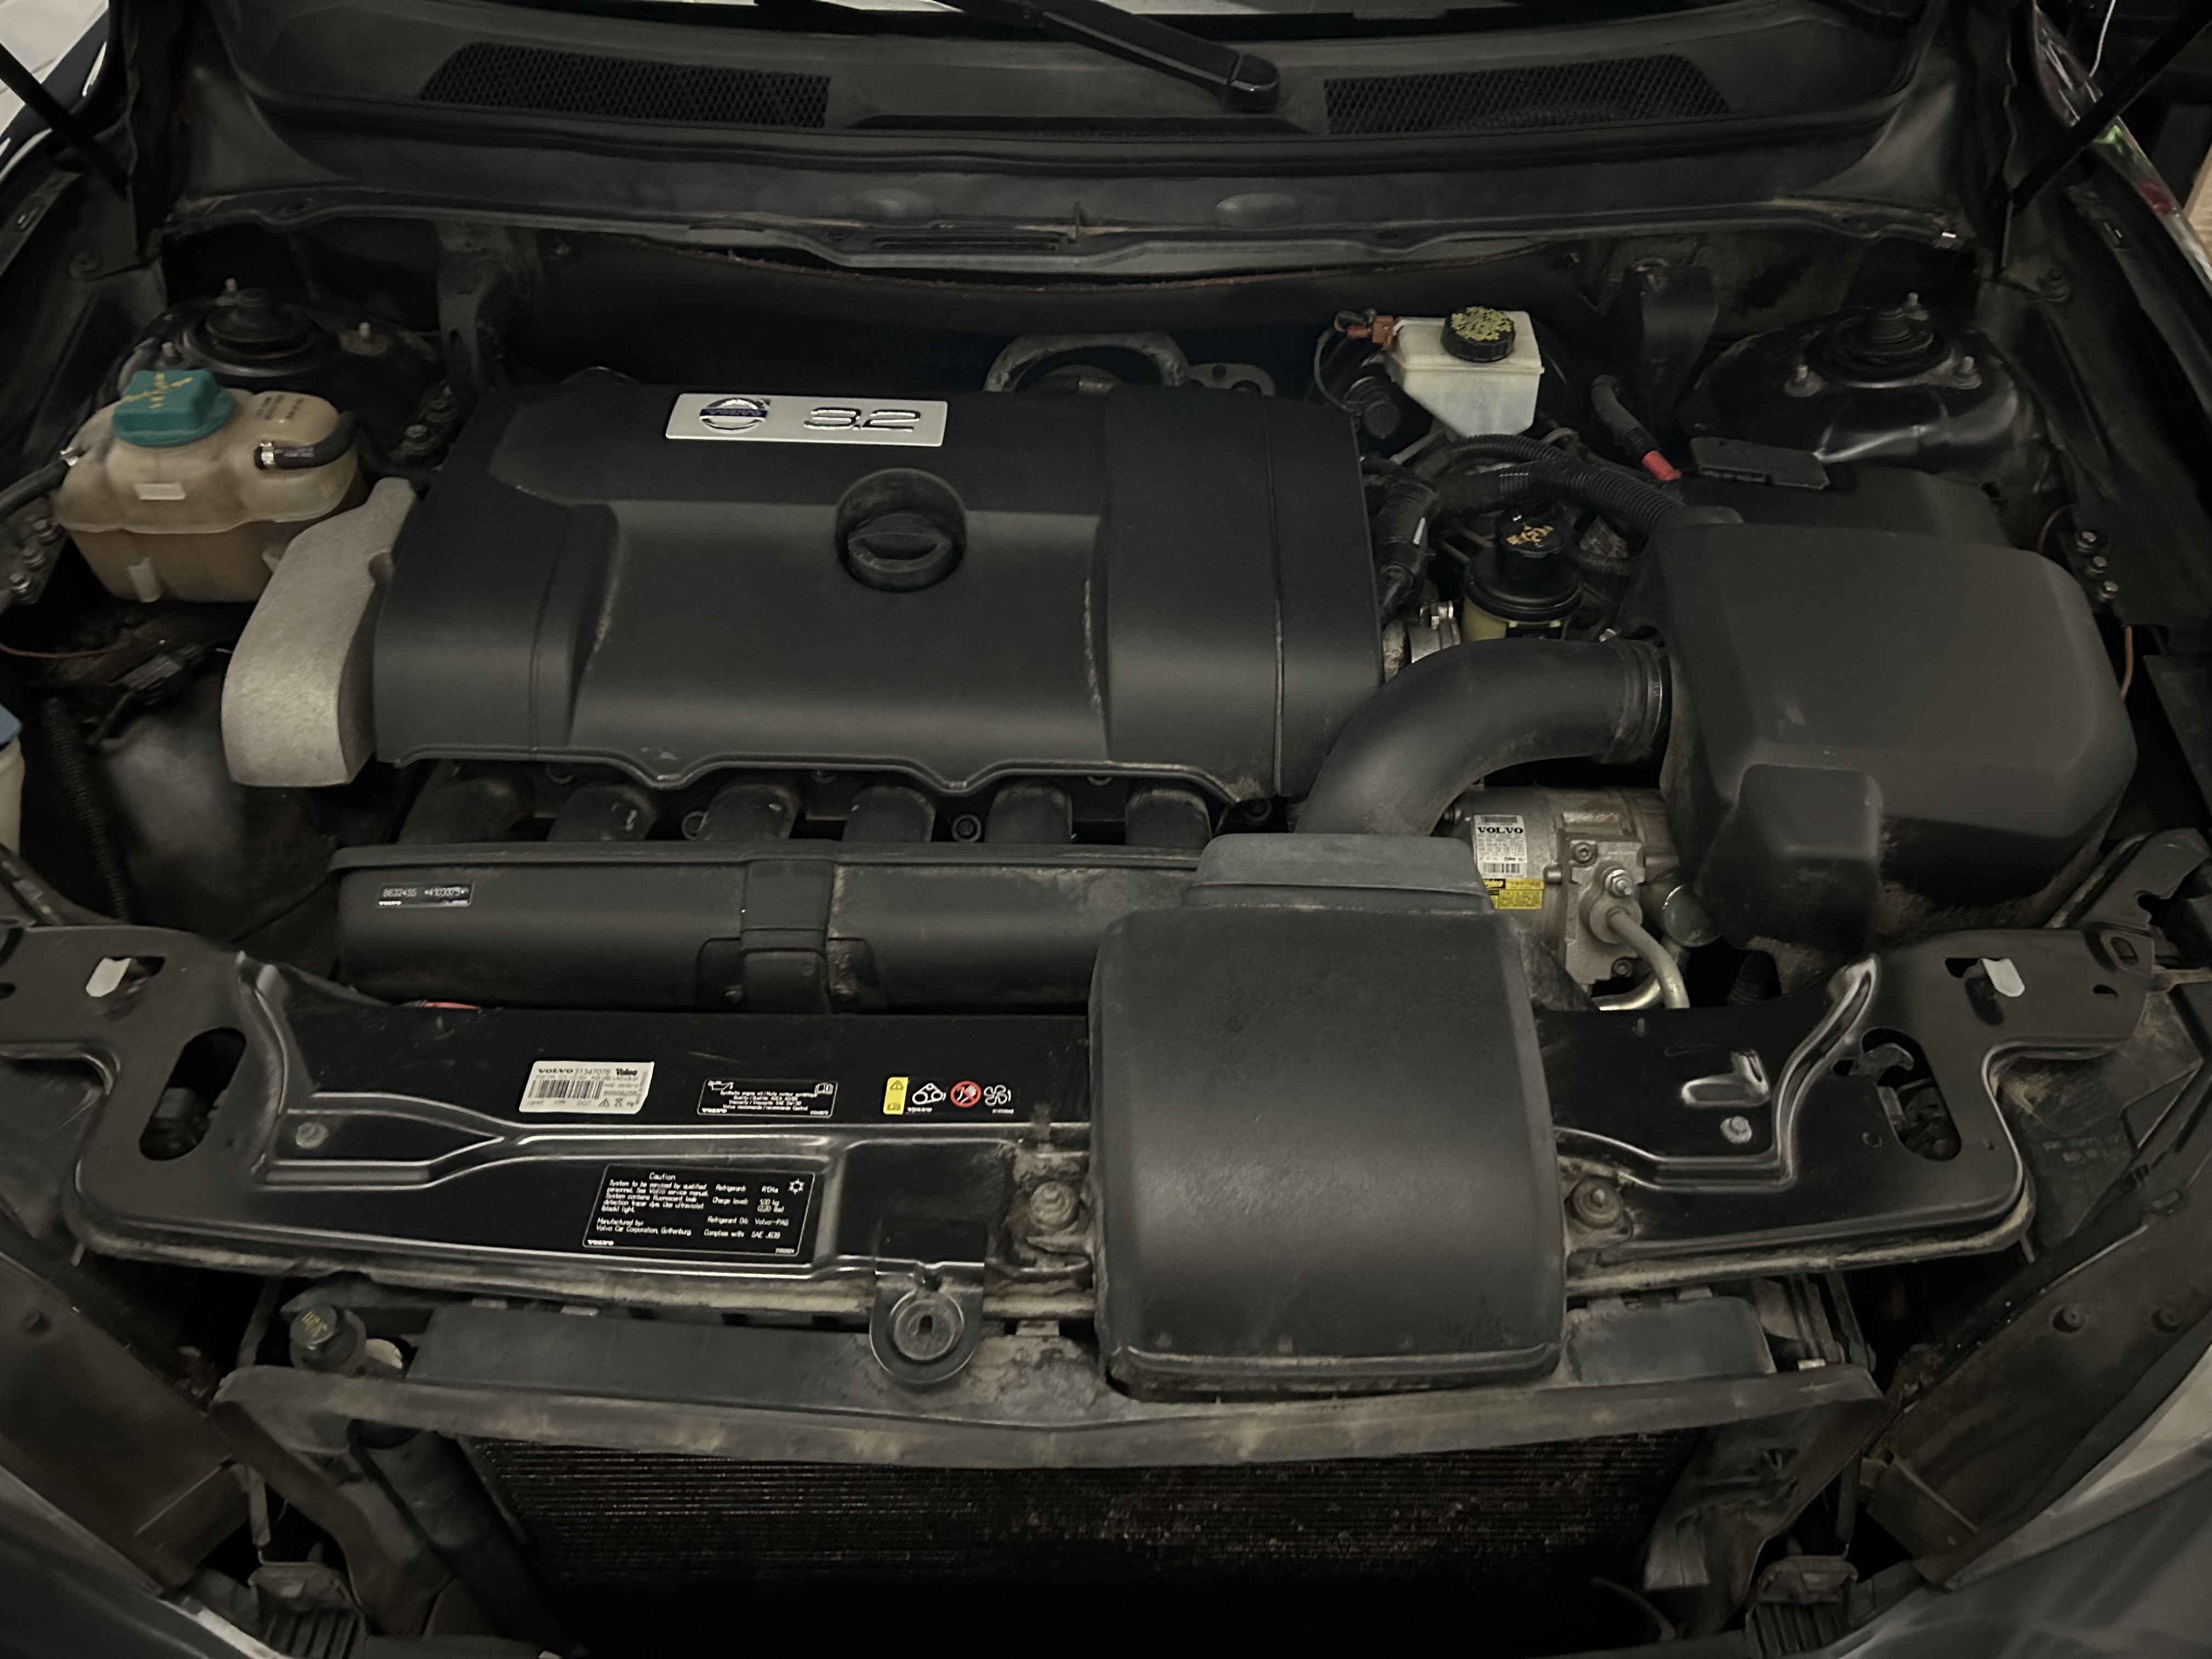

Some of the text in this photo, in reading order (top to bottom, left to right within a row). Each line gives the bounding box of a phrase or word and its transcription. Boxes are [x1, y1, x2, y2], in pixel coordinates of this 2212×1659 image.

[804, 407, 921, 432] 3.2
[649, 1172, 676, 1180] Caution
[597, 1217, 634, 1226] Manufactured
[707, 1215, 737, 1224] Refrigerant
[596, 1224, 613, 1232] Volvo
[751, 1230, 764, 1239] SAE
